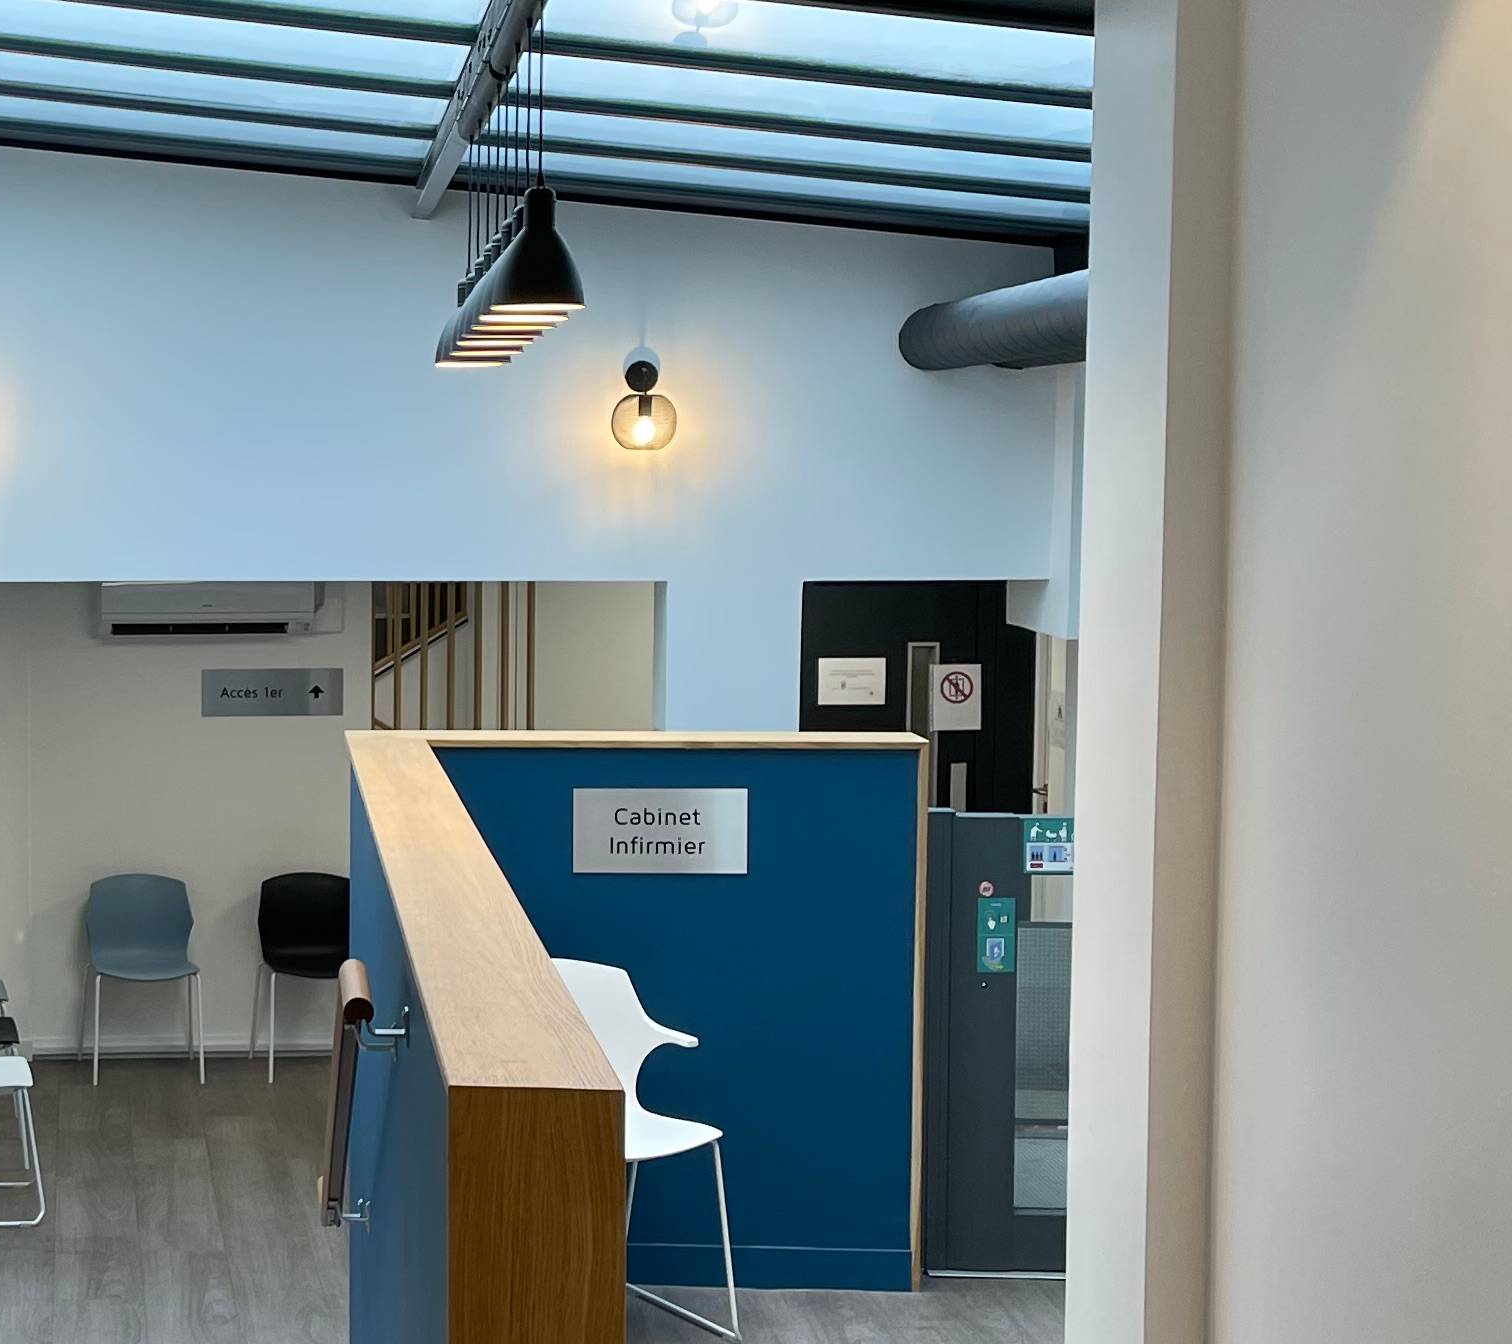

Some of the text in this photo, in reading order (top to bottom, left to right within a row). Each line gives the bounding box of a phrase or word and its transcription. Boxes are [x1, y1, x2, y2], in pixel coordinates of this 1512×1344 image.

[220, 686, 283, 699] Accès 1er
[614, 807, 701, 826] Cabinet
[609, 836, 706, 855] Infirmier
